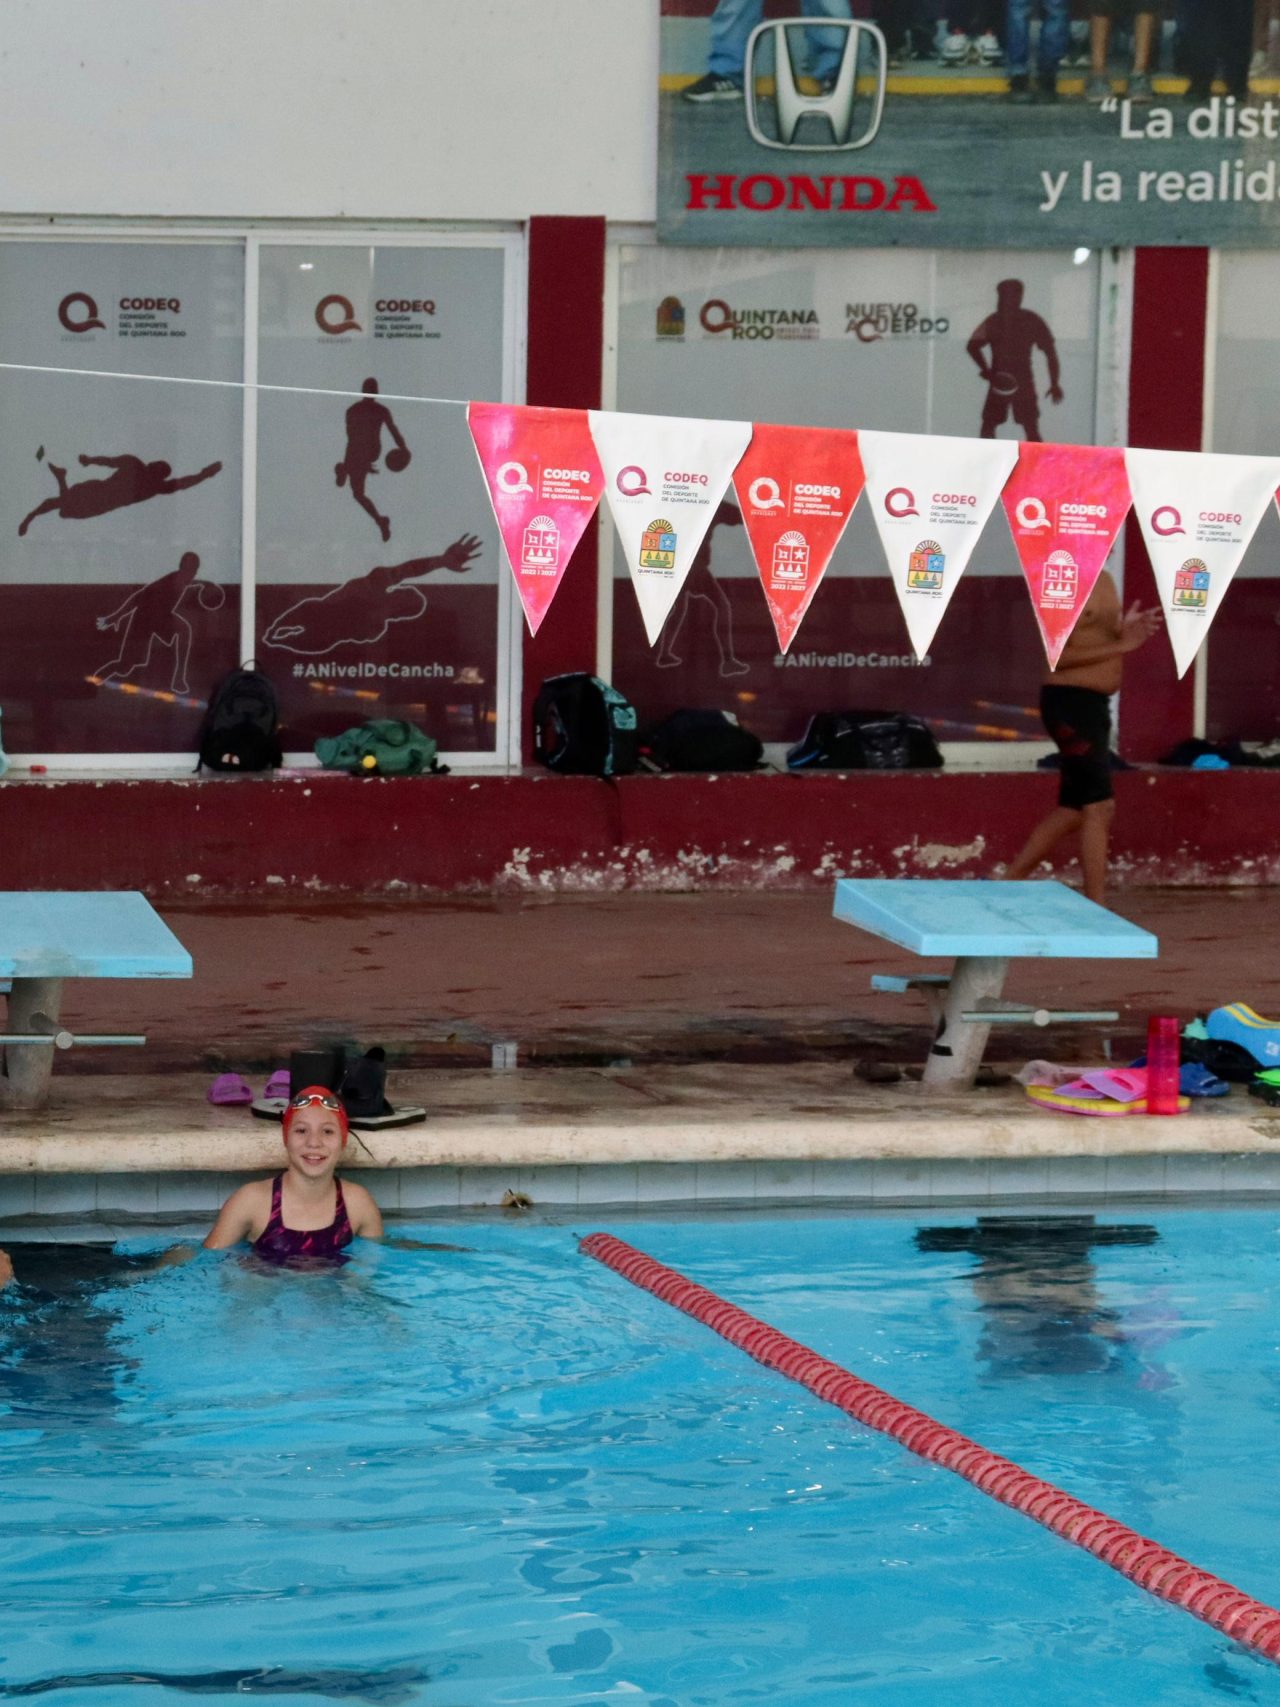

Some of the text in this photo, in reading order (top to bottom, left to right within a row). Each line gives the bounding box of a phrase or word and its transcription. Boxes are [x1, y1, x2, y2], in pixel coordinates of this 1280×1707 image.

[1099, 97, 1173, 139] “La
[685, 174, 938, 212] HONDA
[1039, 159, 1280, 213] y la realid
[119, 297, 181, 314] CODEQ
[375, 299, 436, 316] CODEQ
[846, 302, 918, 319] NUEVO
[700, 299, 819, 333] QUINTANA
[732, 325, 775, 340] ROO
[543, 468, 591, 484] CODEQ
[664, 472, 709, 487] CODEQ
[794, 484, 841, 500] CODEQ
[932, 493, 978, 508] CODEQ
[1060, 503, 1107, 519] CODEQ
[1199, 511, 1242, 526] CODEQ
[292, 661, 455, 678] #ANivelDeCancha
